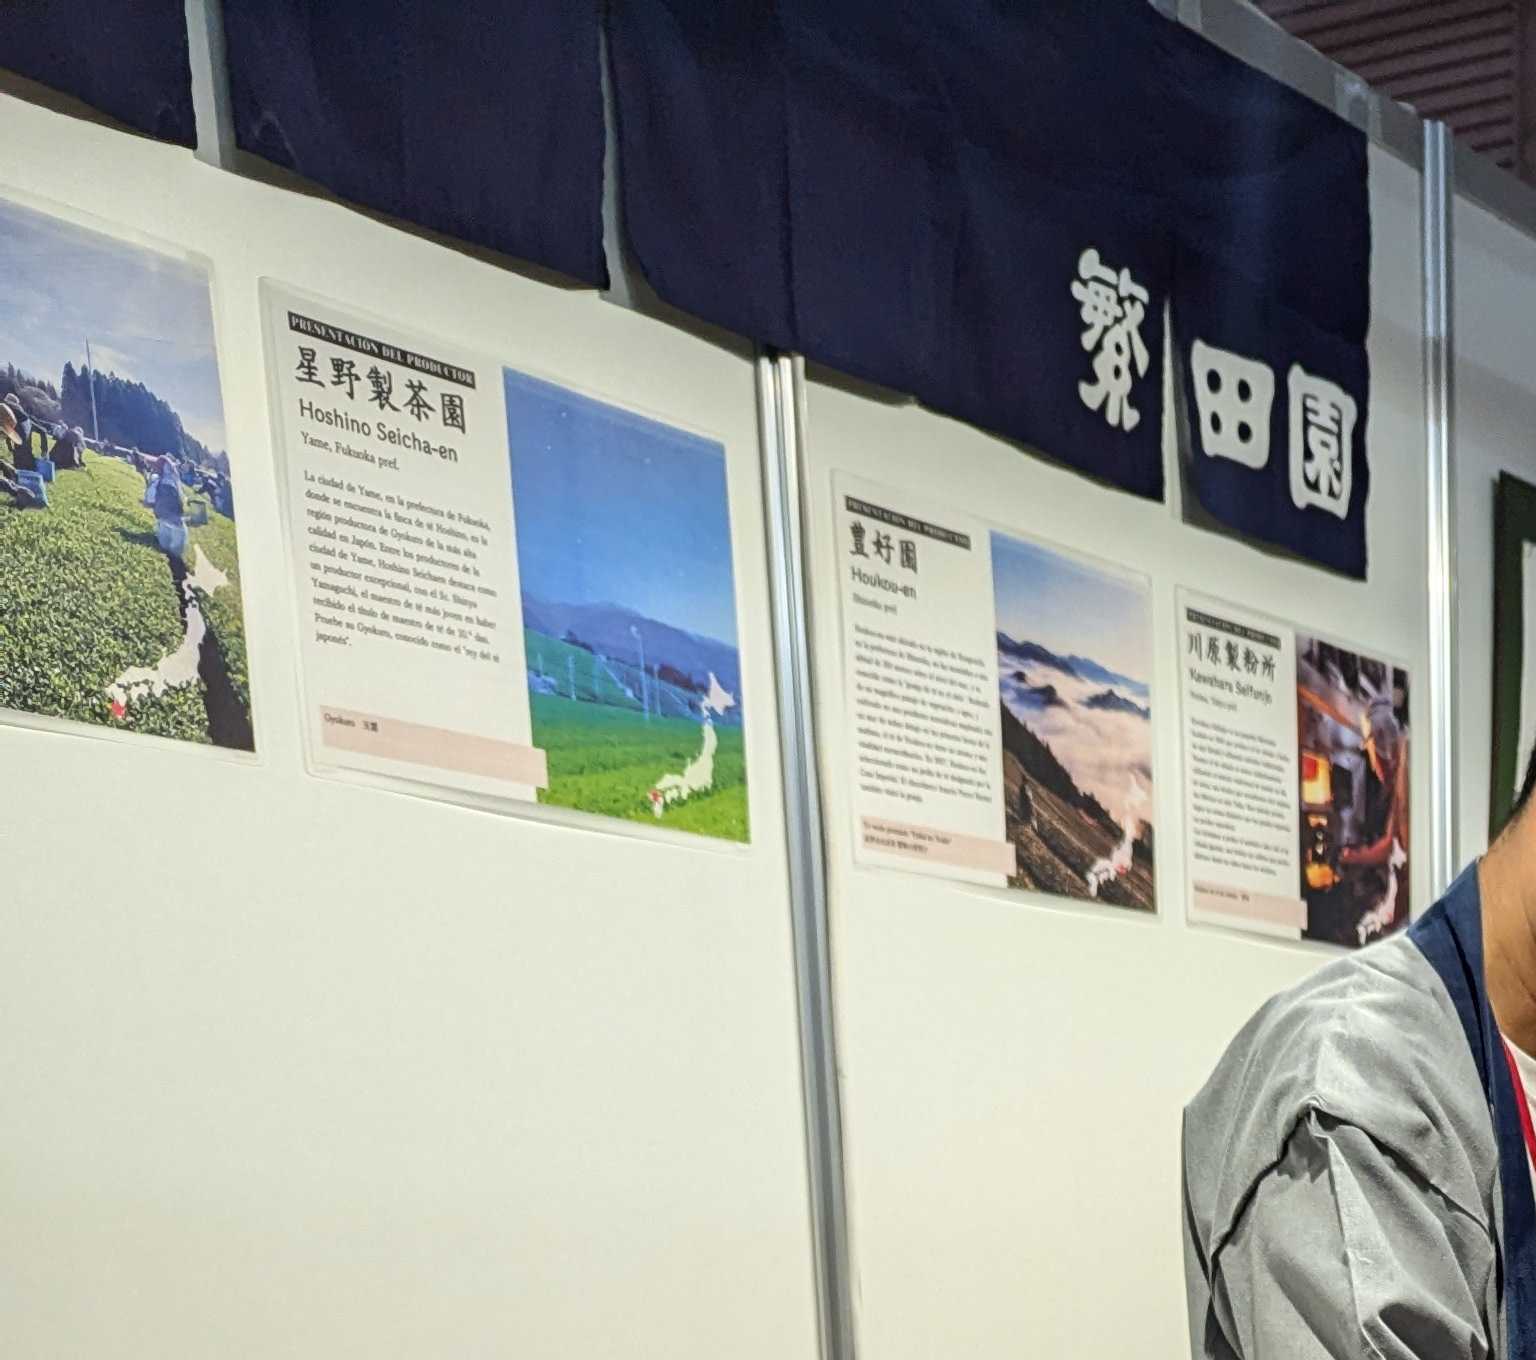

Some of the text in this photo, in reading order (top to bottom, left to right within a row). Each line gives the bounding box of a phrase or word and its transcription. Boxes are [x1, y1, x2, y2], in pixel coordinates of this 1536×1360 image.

[296, 347, 464, 432] 星野製茶園
[406, 351, 472, 383] PRODUCTOR
[1070, 248, 1355, 518] 繁田園
[299, 398, 457, 461] Hoshino Seicha-en
[300, 431, 332, 452] Yame,
[334, 441, 375, 463] Fukuoka
[317, 476, 343, 489] ciudad
